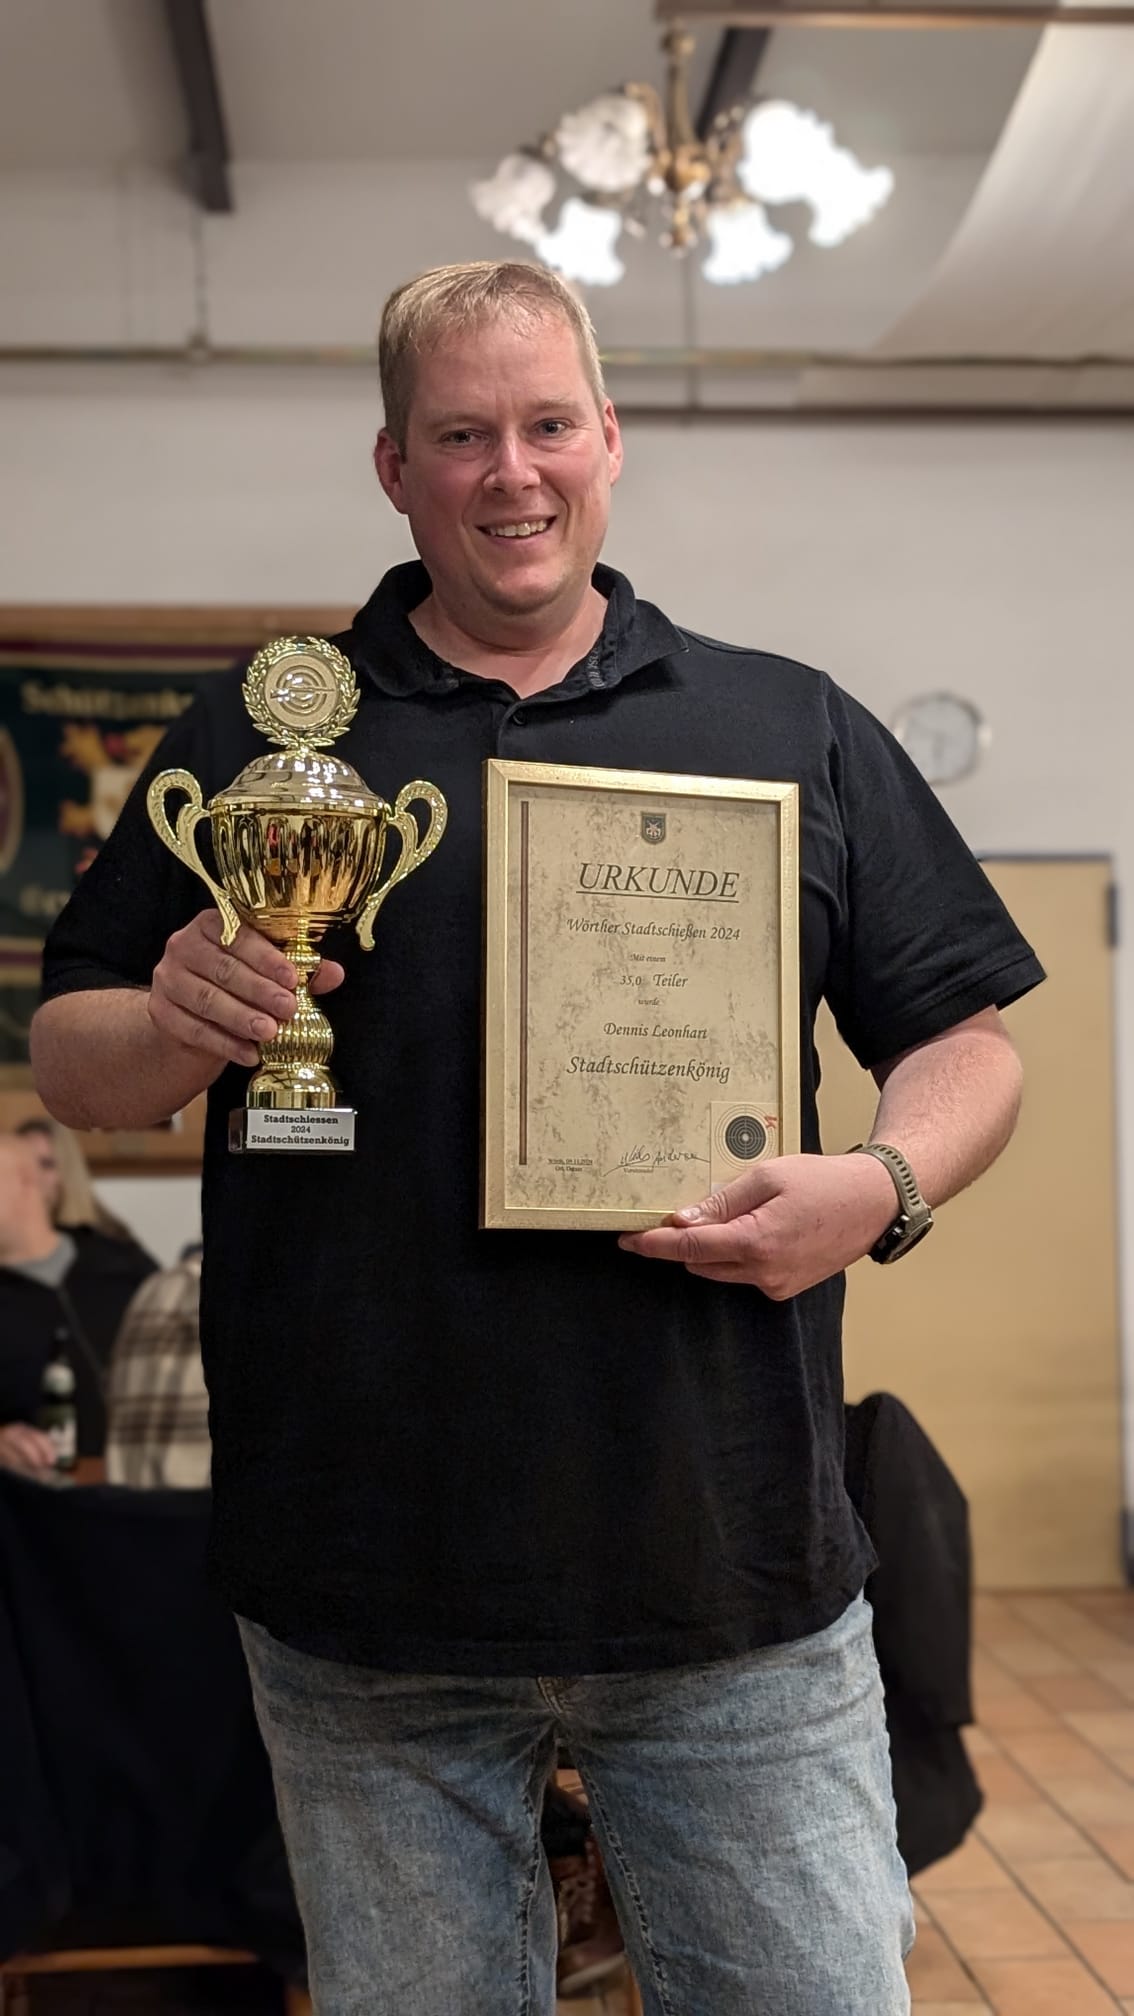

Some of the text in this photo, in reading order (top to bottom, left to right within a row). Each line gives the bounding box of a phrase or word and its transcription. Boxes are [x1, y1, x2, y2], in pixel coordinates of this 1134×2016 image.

[578, 862, 740, 899] URKUNDE
[566, 917, 741, 942] Wörther Stadtschießen 2024
[629, 953, 645, 962] Mit
[619, 973, 688, 988] 35,0 Teiler
[603, 1022, 708, 1040] Dennis Leonhart
[566, 1055, 731, 1084] Stadtschützenkönig
[263, 1114, 339, 1124] Stadtschiessen
[291, 1126, 311, 1134] 2024
[251, 1135, 350, 1146] Stadtschützenkönig
